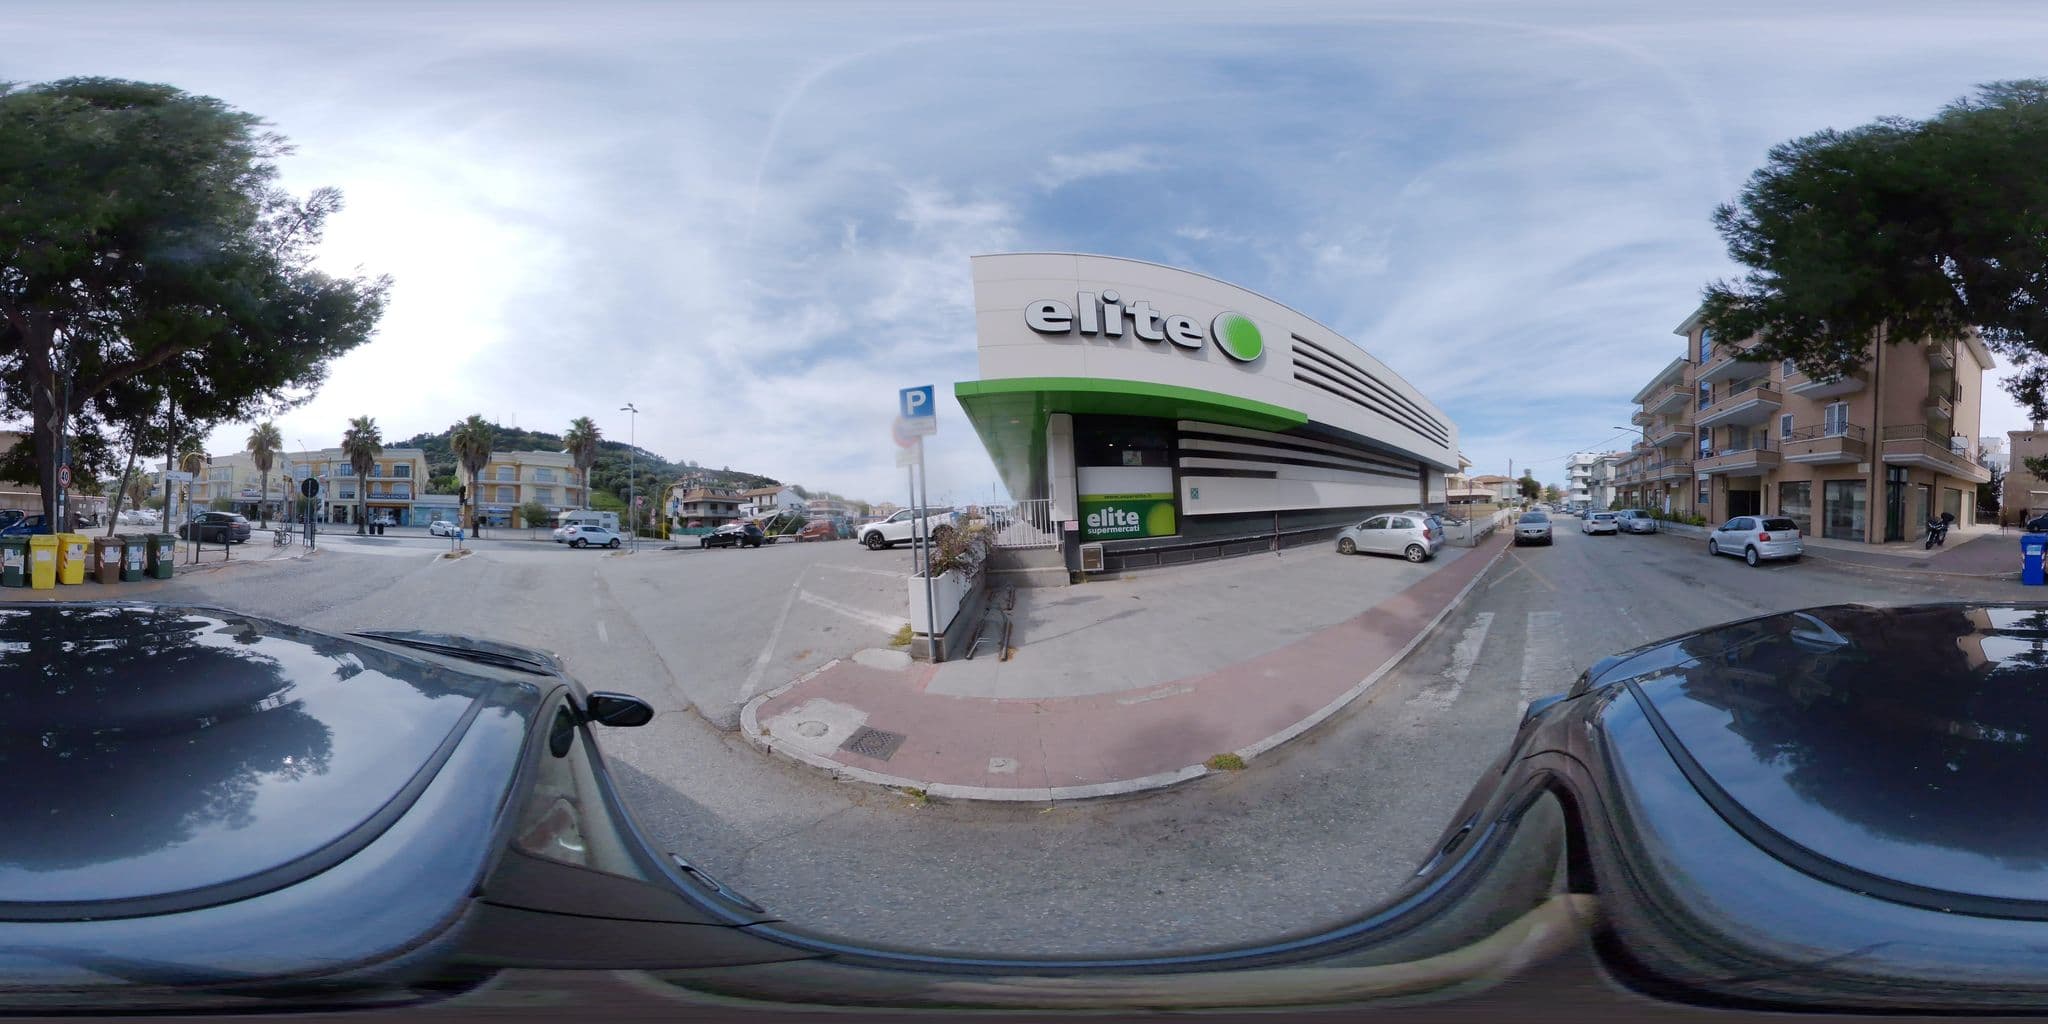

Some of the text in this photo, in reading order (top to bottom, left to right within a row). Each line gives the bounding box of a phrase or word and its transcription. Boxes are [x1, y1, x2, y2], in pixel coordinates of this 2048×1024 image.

[1025, 289, 1203, 349] elite
[906, 390, 926, 416] P
[1087, 506, 1139, 527] elite
[1087, 525, 1140, 535] supermercati
